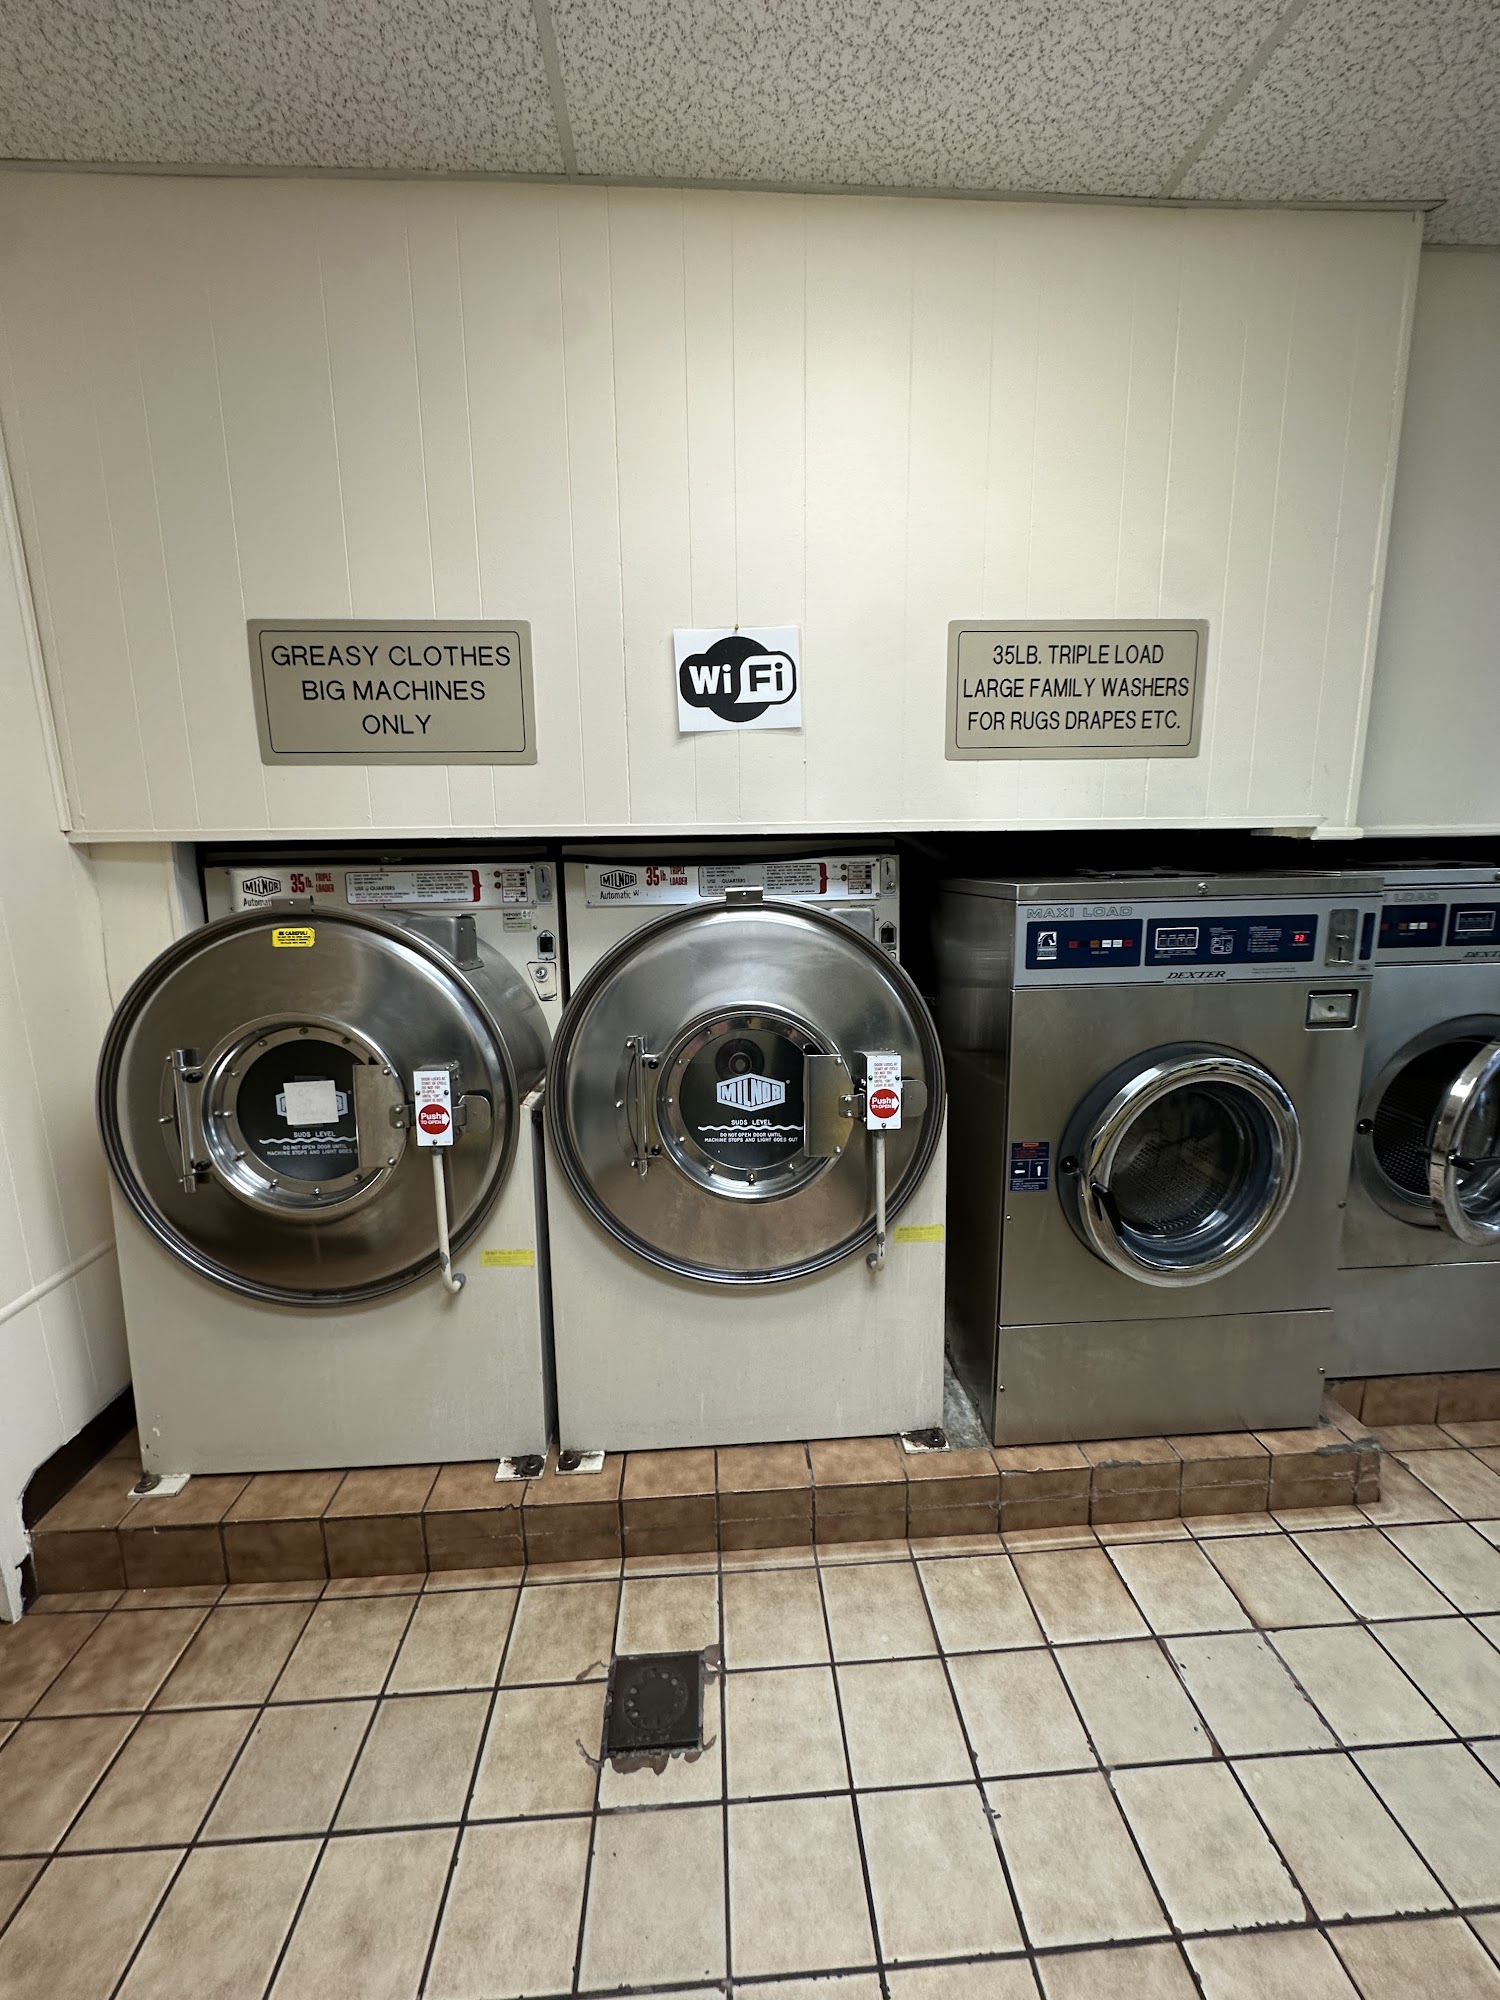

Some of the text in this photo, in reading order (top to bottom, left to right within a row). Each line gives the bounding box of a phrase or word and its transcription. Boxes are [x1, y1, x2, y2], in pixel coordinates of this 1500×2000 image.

[271, 645, 511, 666] GREASY CLOTHES
[993, 644, 1165, 665] 35LB. TRIPLE LOAD
[688, 662, 783, 695] Wi Fi
[302, 680, 486, 701] BIG MACHINES
[963, 677, 1190, 699] LARGE FAMILY WASHERS
[362, 714, 432, 735] ONLY
[968, 710, 1182, 731] FOR RUGS DRAPES ETC.
[315, 873, 333, 882] TRIPLE
[645, 867, 660, 886] 35
[670, 866, 686, 875] TRIPLE
[245, 879, 279, 894] MILNOR
[290, 873, 305, 893] 35
[603, 872, 635, 888] MILNOR
[669, 877, 688, 886] LOADER
[315, 884, 335, 893] LOADER
[600, 890, 632, 900] Automatic
[243, 898, 272, 907] Automat
[1393, 892, 1439, 903] LOAD
[1026, 906, 1132, 919] MAXI LOAD
[1167, 970, 1226, 979] DEXTER
[722, 1078, 781, 1107] MILNOR
[872, 1097, 891, 1105] Push
